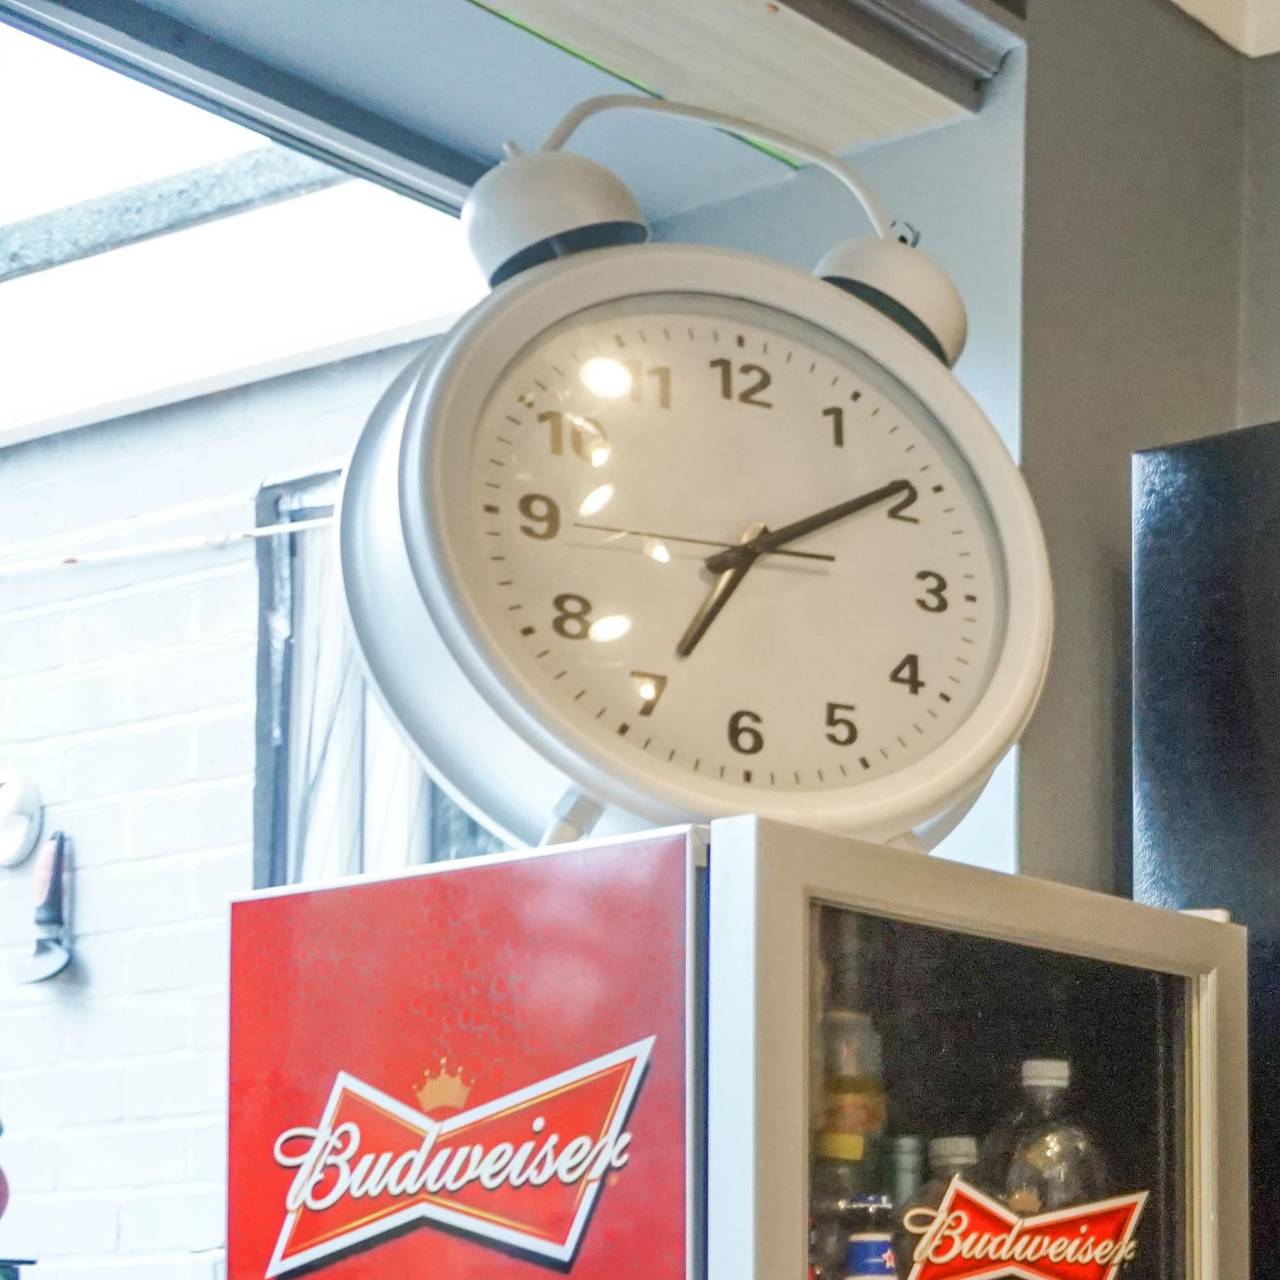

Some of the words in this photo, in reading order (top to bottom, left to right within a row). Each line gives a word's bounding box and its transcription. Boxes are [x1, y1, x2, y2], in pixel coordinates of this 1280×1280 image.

[626, 359, 671, 409] 11
[709, 357, 774, 409] 12
[538, 410, 608, 466] 10
[822, 406, 845, 448] 1
[518, 493, 561, 540] 9
[887, 480, 920, 524] 2
[915, 570, 949, 614] 3
[551, 593, 594, 641] 8
[629, 669, 668, 717] 7
[888, 653, 925, 695] 4
[726, 709, 766, 755] 6
[825, 702, 859, 748] 5
[273, 1116, 633, 1212] Budweiser
[903, 1207, 1138, 1266] Budweiser
